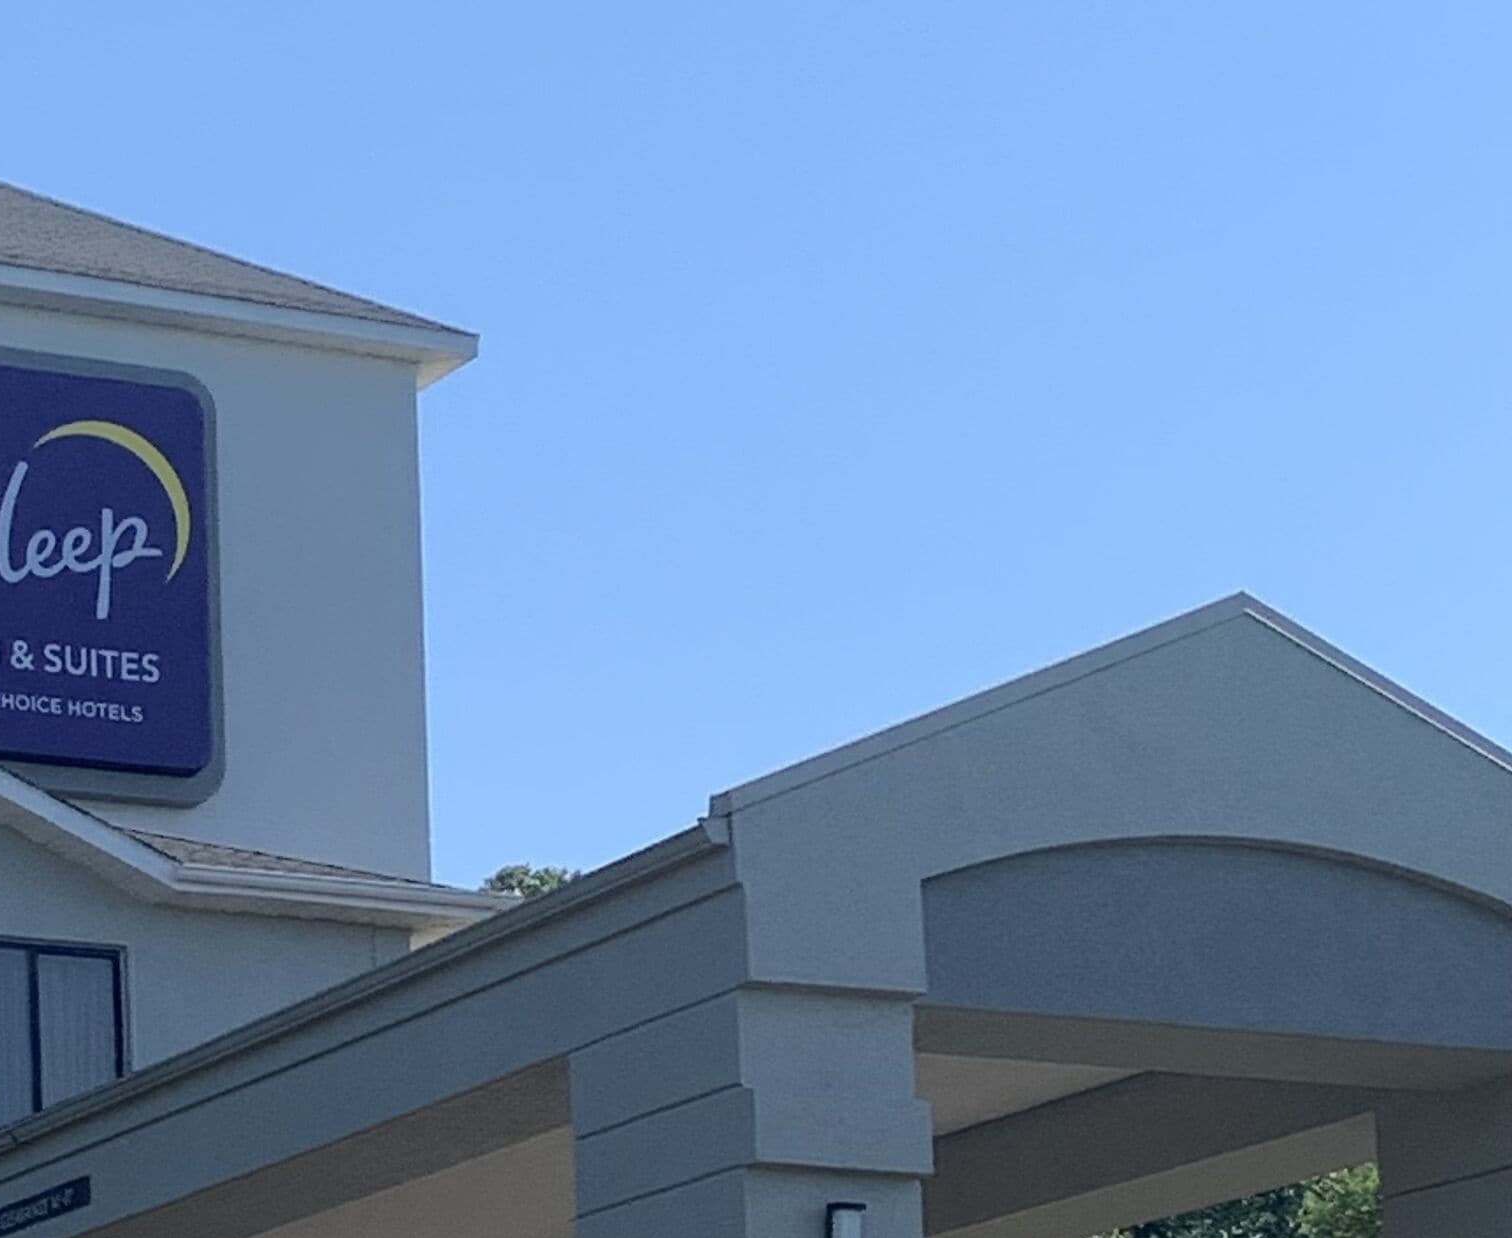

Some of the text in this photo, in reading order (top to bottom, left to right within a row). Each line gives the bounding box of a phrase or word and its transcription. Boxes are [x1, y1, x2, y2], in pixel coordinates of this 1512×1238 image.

[11, 638, 35, 671] &
[44, 644, 161, 683] SUITES
[68, 700, 144, 723] HOTELS
